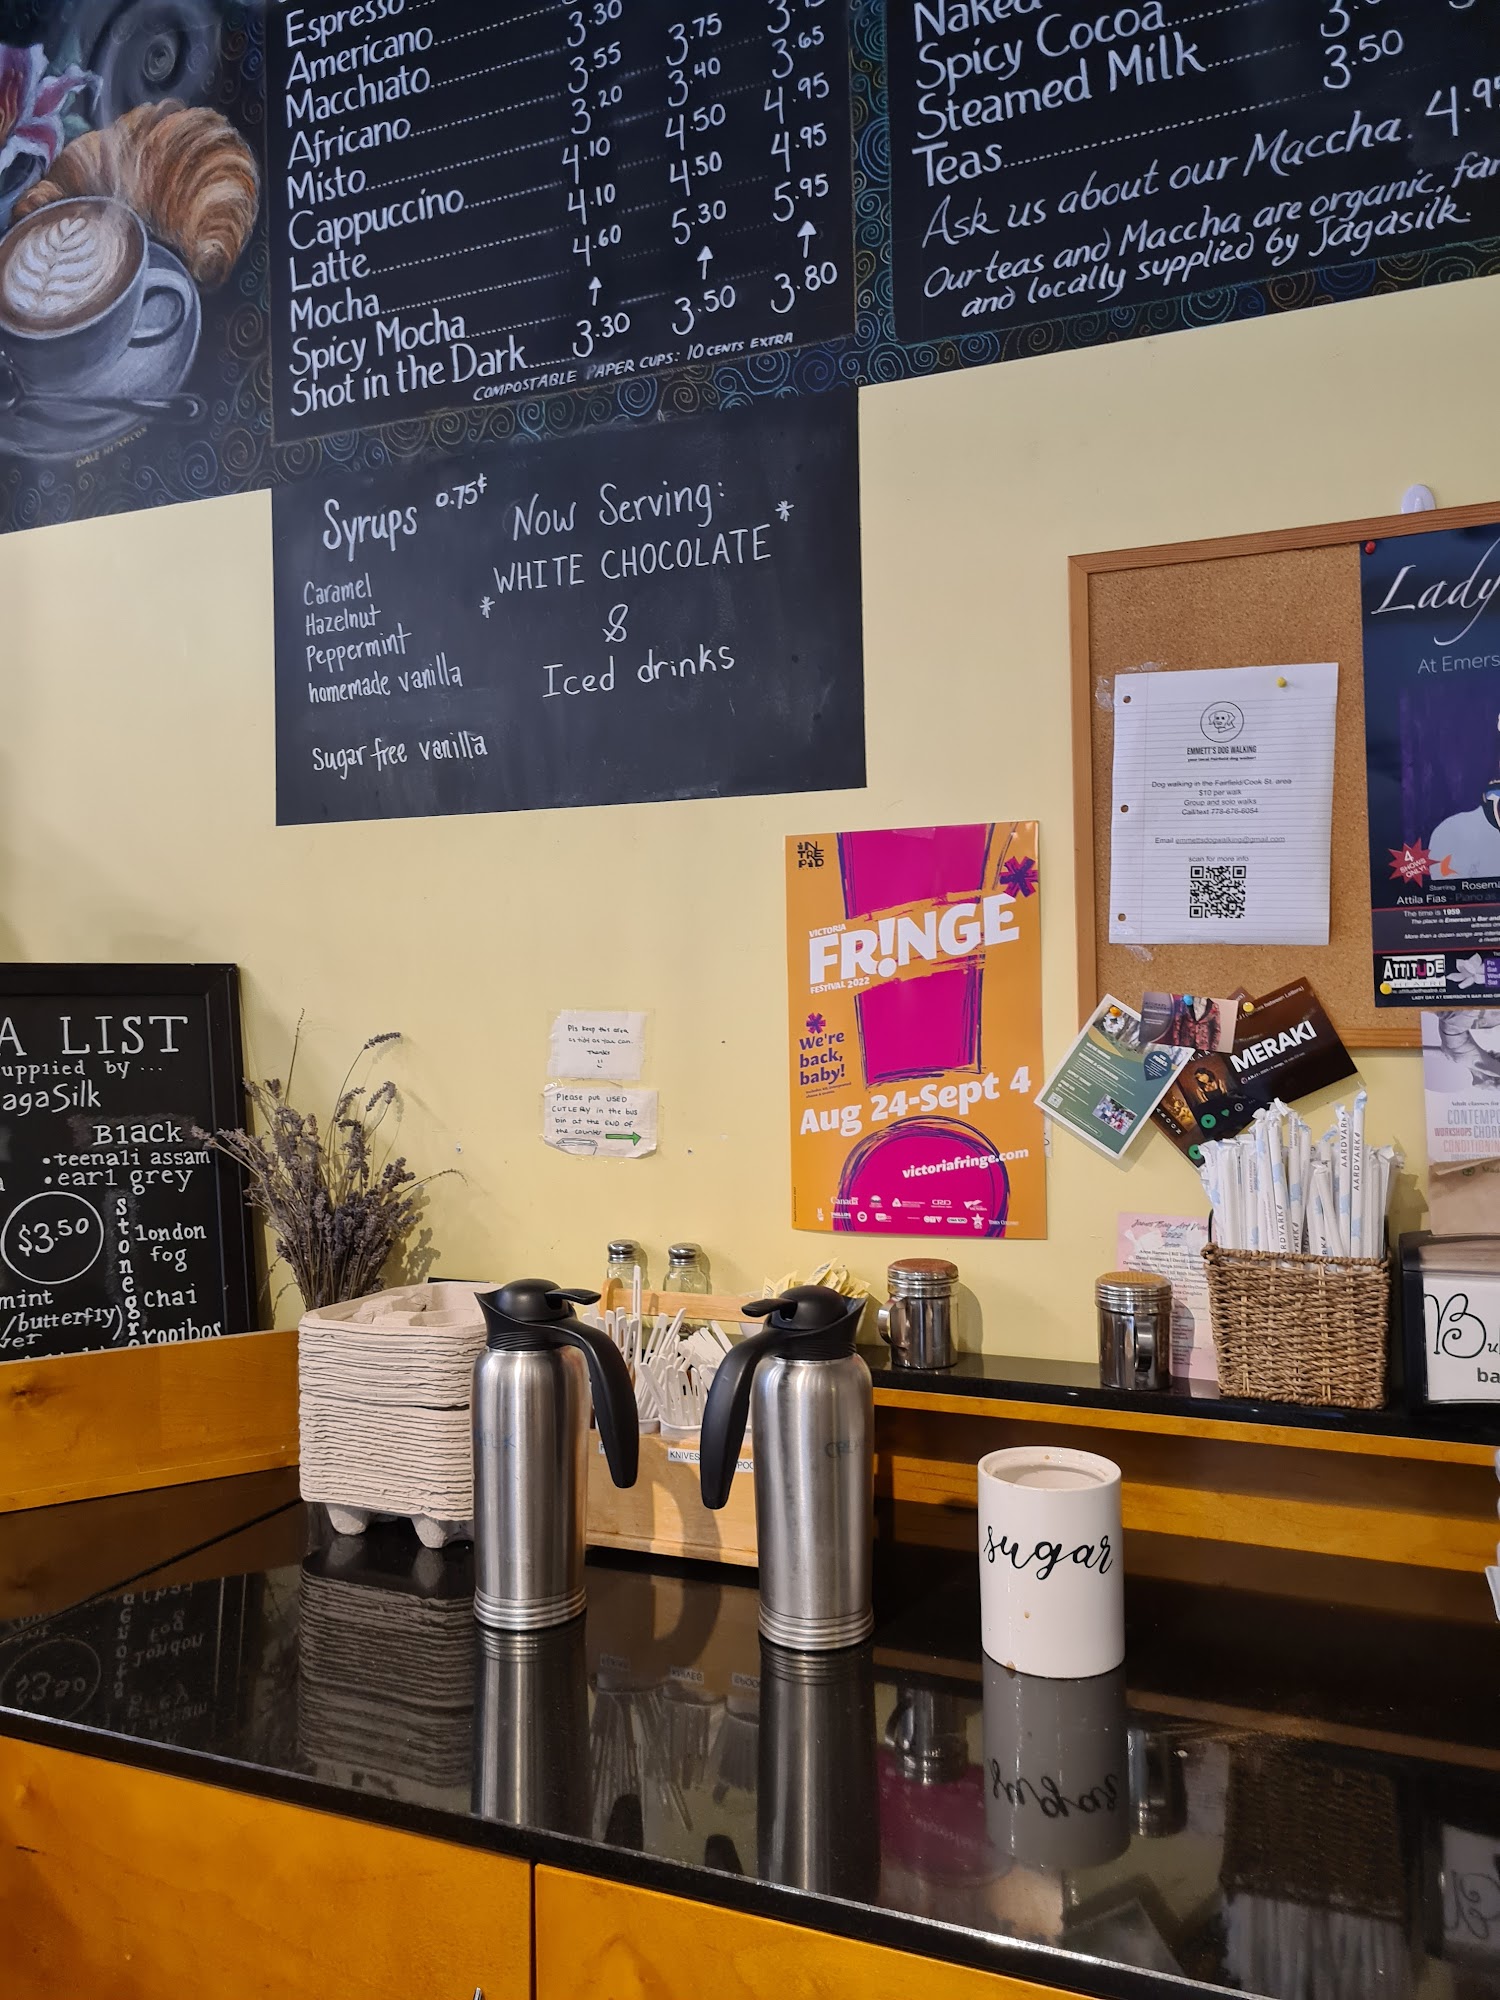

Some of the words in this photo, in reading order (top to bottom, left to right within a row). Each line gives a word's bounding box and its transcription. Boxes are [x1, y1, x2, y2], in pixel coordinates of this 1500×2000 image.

[286, 0, 404, 48] Espresso
[285, 27, 433, 90] Americano
[286, 65, 431, 128] Macchiato
[567, 0, 622, 47] 3.30
[916, 37, 1023, 96] Spicy
[1036, 0, 1166, 57] Cocoa
[288, 118, 411, 169] Africano
[568, 42, 621, 93] 3.55
[666, 13, 722, 66] 3.75
[917, 58, 1092, 140] Steamed
[1108, 31, 1207, 92] Milk
[1323, 29, 1403, 89] 3.50
[287, 166, 366, 210] Misto
[571, 85, 622, 134] 3.20
[668, 57, 720, 107] 3.40
[771, 25, 824, 79] 3.65
[289, 188, 464, 250] Cappuccino
[562, 137, 611, 184] 4.10
[665, 103, 725, 150] 4.50
[764, 72, 829, 124] 4.95
[912, 141, 1003, 187] Teas
[922, 195, 1000, 249] Ask
[1007, 199, 1047, 228] us
[1057, 159, 1160, 214] about
[1169, 156, 1239, 190] our
[1243, 110, 1413, 177] Maccha.
[289, 250, 371, 292] Latte
[568, 184, 616, 225] 4.10
[669, 151, 722, 197] 4.50
[771, 122, 827, 173] 4.95
[291, 287, 380, 332] Mocha
[573, 225, 621, 267] 4.60
[672, 200, 727, 245] 5.30
[773, 173, 829, 221] 5.95
[924, 266, 982, 298] Our
[985, 250, 1045, 284] teas
[1053, 227, 1112, 270] and
[1119, 204, 1241, 256] Maccha
[1253, 201, 1302, 228] are
[961, 286, 1016, 318] and
[1027, 263, 1126, 303] locally
[1136, 232, 1254, 286] supplied
[1265, 227, 1300, 267] by
[289, 335, 366, 380] Spicy
[376, 308, 465, 356] Mocha
[291, 372, 355, 417] Shot
[363, 368, 390, 400] in
[396, 355, 445, 393] the
[450, 335, 527, 383] Dark
[573, 312, 630, 358] 3.30
[672, 285, 736, 335] 3.50
[771, 262, 837, 314] 3.80
[473, 371, 577, 401] COMPOSTABLE
[587, 356, 635, 379] PAPER
[639, 352, 680, 369] CUPS:
[687, 344, 704, 359] 10
[706, 341, 744, 357] CENTS
[750, 332, 793, 349] EXTRA
[599, 480, 725, 528] Serving:
[323, 499, 417, 562] Syrups
[493, 553, 585, 594] WHITE
[600, 523, 772, 580] CHOCOLATE
[303, 572, 372, 606] Caramel
[1370, 537, 1500, 646] Lady
[305, 603, 381, 636] Hazelnut
[306, 622, 412, 673] Peppermint
[1417, 658, 1438, 675] At
[308, 670, 391, 703] homemade
[398, 652, 463, 692] vanilla
[542, 655, 615, 698] Iced
[637, 643, 735, 683] drinks
[370, 737, 407, 771] free
[419, 730, 488, 761] vanilla
[1187, 746, 1217, 755] EMMETT'S
[1218, 746, 1229, 755] DOG
[1231, 745, 1257, 754] WALKING
[1151, 781, 1166, 789] Dog
[1167, 781, 1193, 789] walking
[1184, 799, 1205, 807] Group
[1400, 858, 1427, 874] SHOWS
[1404, 850, 1415, 863] 4
[1396, 894, 1424, 905] Attila
[1426, 894, 1447, 904] Fias
[1403, 910, 1417, 918] The
[1418, 909, 1434, 917] time
[808, 923, 846, 938] VICTORIA
[809, 892, 1020, 985] FR!NGE
[810, 983, 846, 994] FESTIVAL
[847, 977, 870, 988] 2022
[1383, 959, 1446, 980] ATTITUDE
[59, 1015, 189, 1056] LIST
[567, 1024, 579, 1032] Pls
[799, 1031, 845, 1050] We're
[1230, 1020, 1317, 1073] MERAKI
[104, 1060, 131, 1080] by
[800, 1047, 843, 1068] back,
[800, 1064, 845, 1085] baby!
[551, 1106, 591, 1115] CUTLERY
[596, 1106, 604, 1114] in
[556, 1093, 583, 1101] Please
[588, 1095, 601, 1103] put
[800, 1103, 863, 1137] Aug
[870, 1073, 1000, 1122] 24-Sept
[1009, 1066, 1032, 1095] 4
[1434, 1127, 1472, 1137] WORKSHOPS
[150, 1150, 212, 1166] assam
[902, 1148, 1029, 1179] victoriafringe.com
[1353, 1137, 1361, 1191] AARDVARK
[57, 1168, 118, 1187] earl
[129, 1168, 194, 1196] grey
[18, 1217, 90, 1257] $3.50
[150, 1245, 188, 1273] fog
[669, 1450, 701, 1462] KNIVES
[984, 1525, 1113, 1581] sugar
